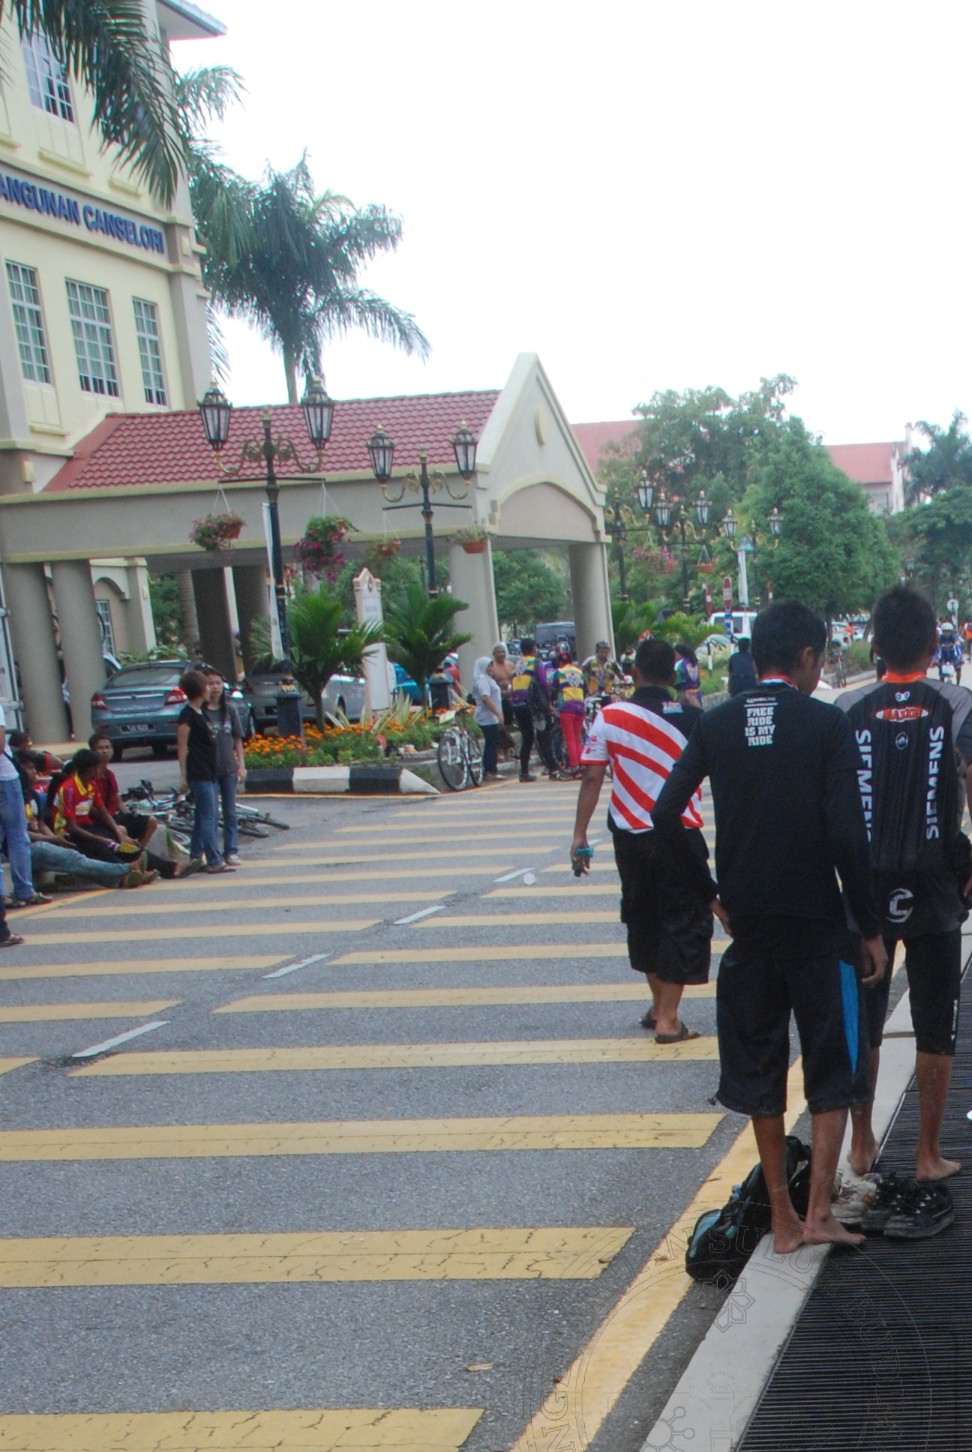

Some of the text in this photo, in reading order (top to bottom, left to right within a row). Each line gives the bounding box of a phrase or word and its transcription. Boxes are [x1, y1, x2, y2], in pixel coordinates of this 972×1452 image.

[82, 203, 165, 255] CANSELORI
[746, 706, 775, 717] FREE
[747, 716, 773, 727] RIDE
[745, 725, 776, 737] IS MY
[747, 735, 774, 747] RIDE
[926, 725, 945, 841] SIEMENS
